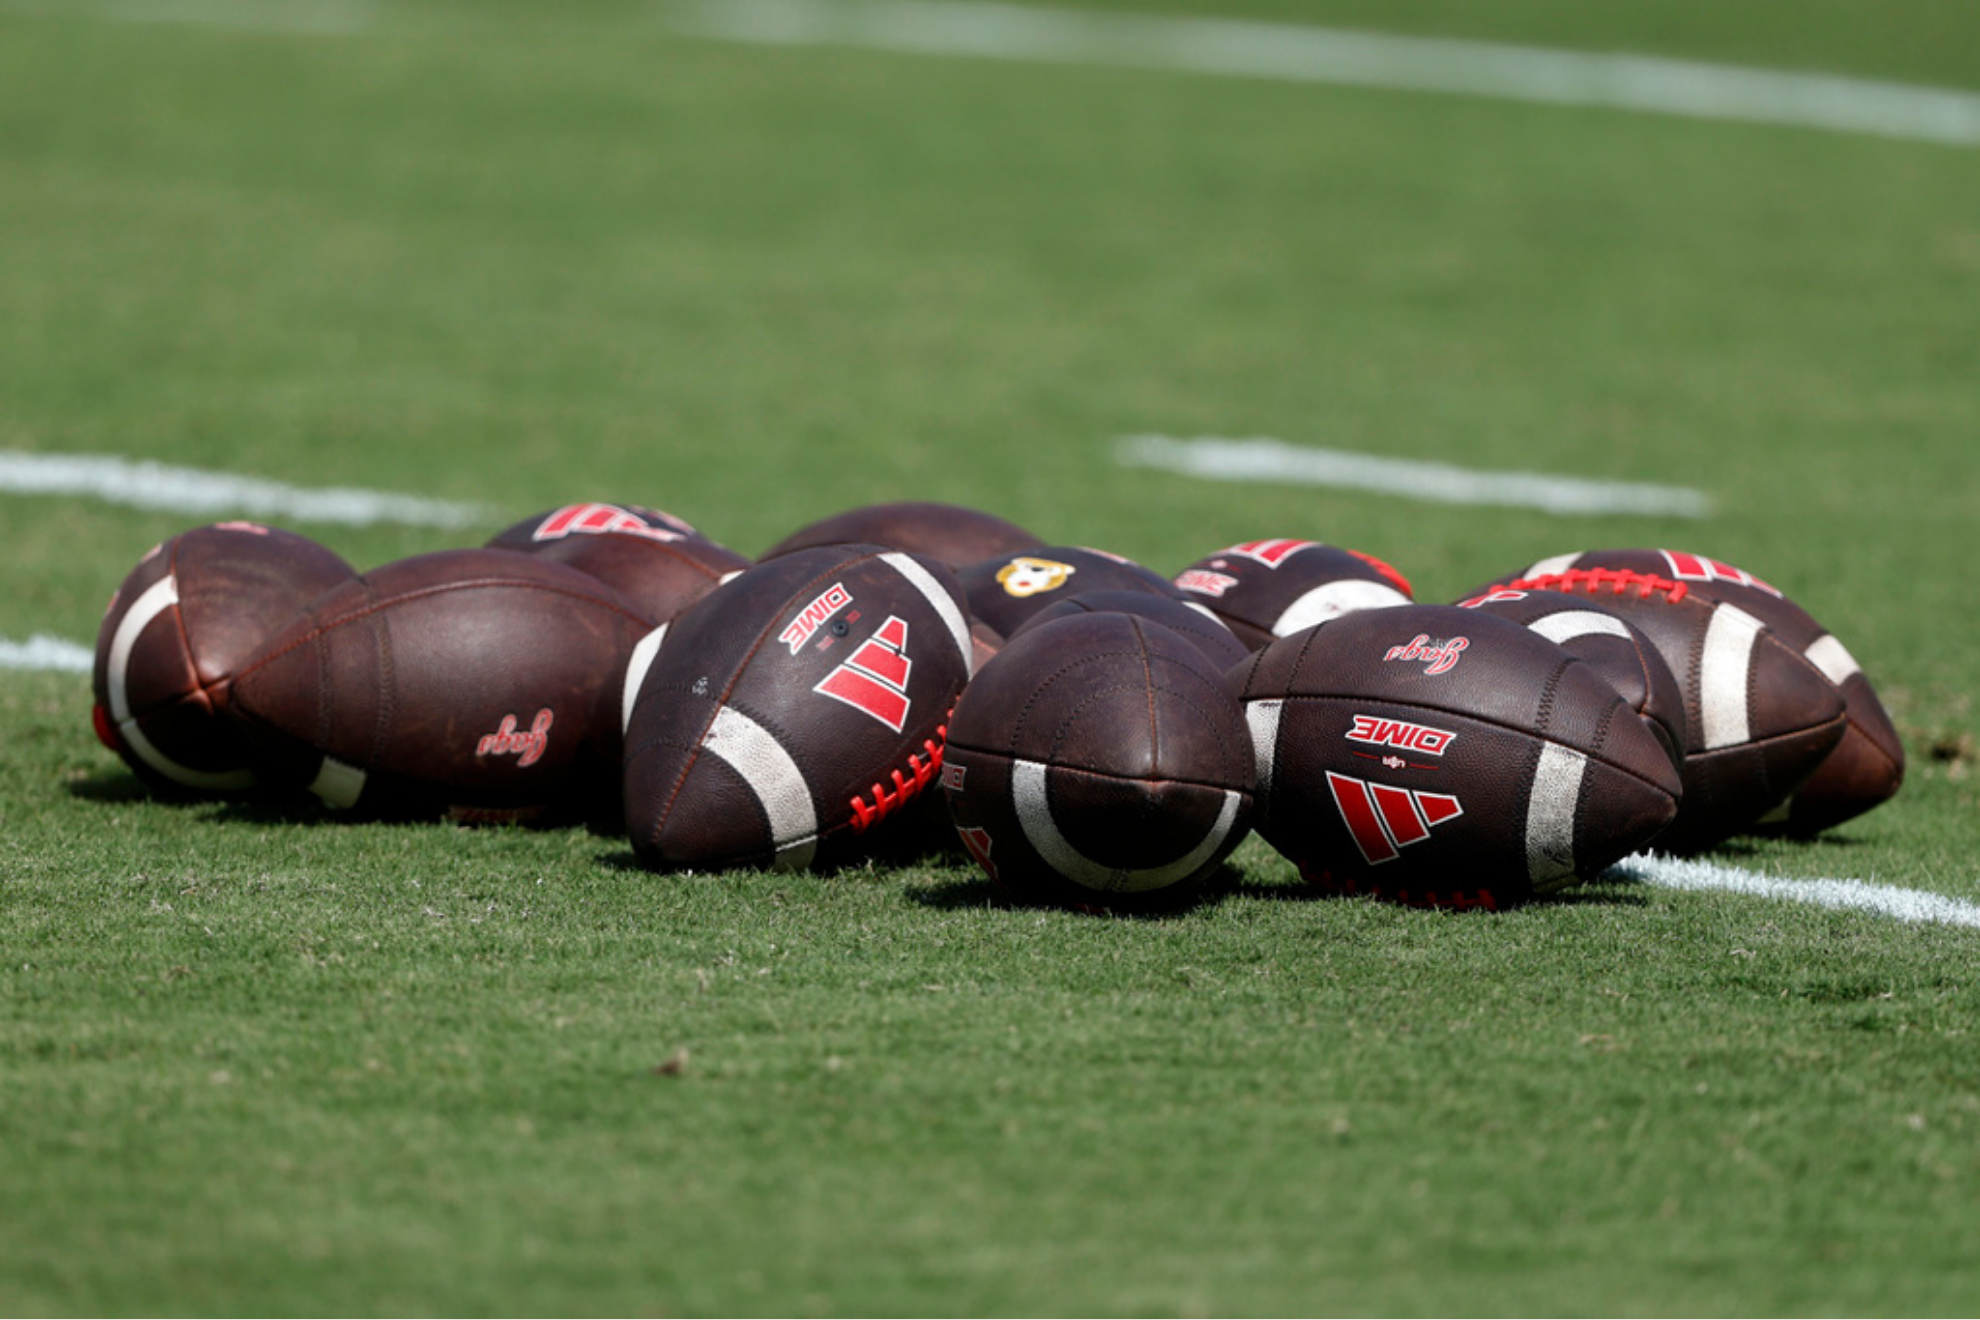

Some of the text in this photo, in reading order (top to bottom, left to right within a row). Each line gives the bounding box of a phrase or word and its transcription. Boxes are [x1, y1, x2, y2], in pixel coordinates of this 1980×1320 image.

[778, 582, 853, 656] DIME
[1383, 634, 1470, 676] Jags
[476, 708, 555, 768] Jags
[1346, 714, 1457, 755] DIME
